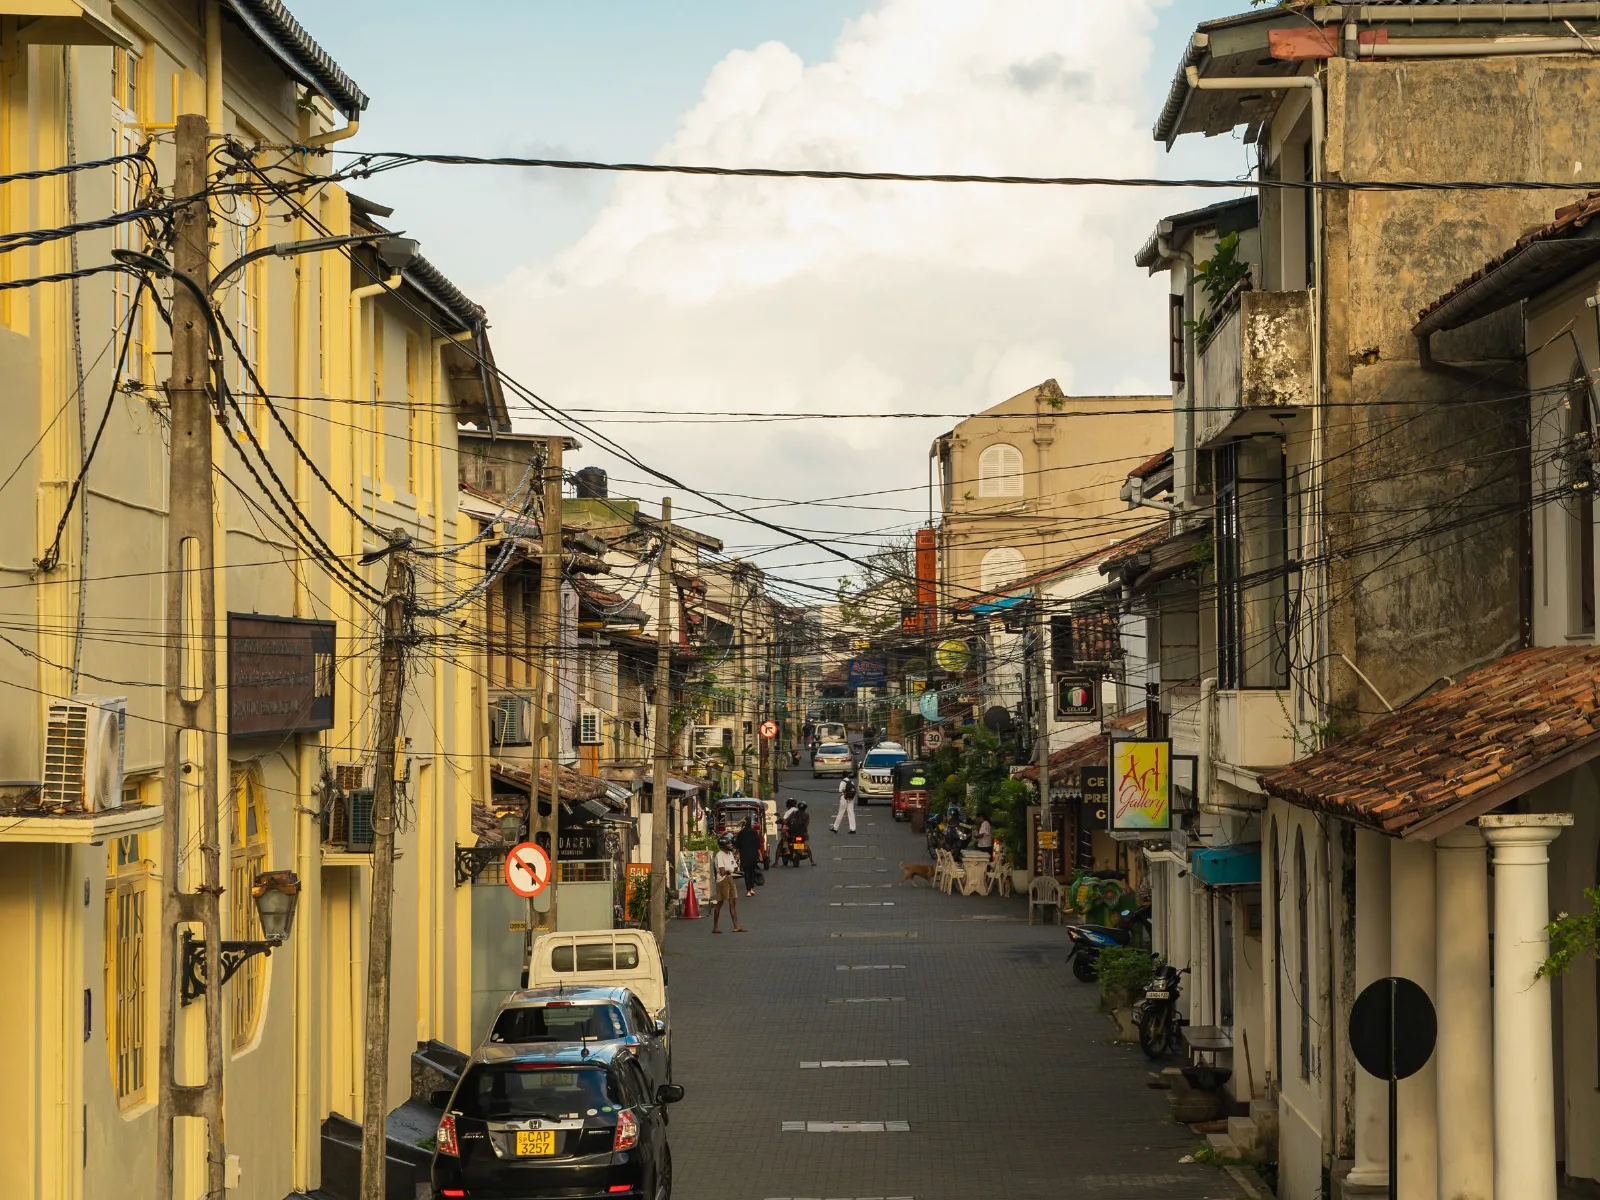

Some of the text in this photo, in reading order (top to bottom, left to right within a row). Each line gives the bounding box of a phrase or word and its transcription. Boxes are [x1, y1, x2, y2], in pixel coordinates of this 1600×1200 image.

[927, 733, 940, 742] 30
[1119, 747, 1163, 792] Art
[1087, 777, 1108, 787] CE
[1116, 786, 1165, 819] Gallery
[528, 1131, 551, 1142] CAP
[521, 1143, 550, 1154] 3257
